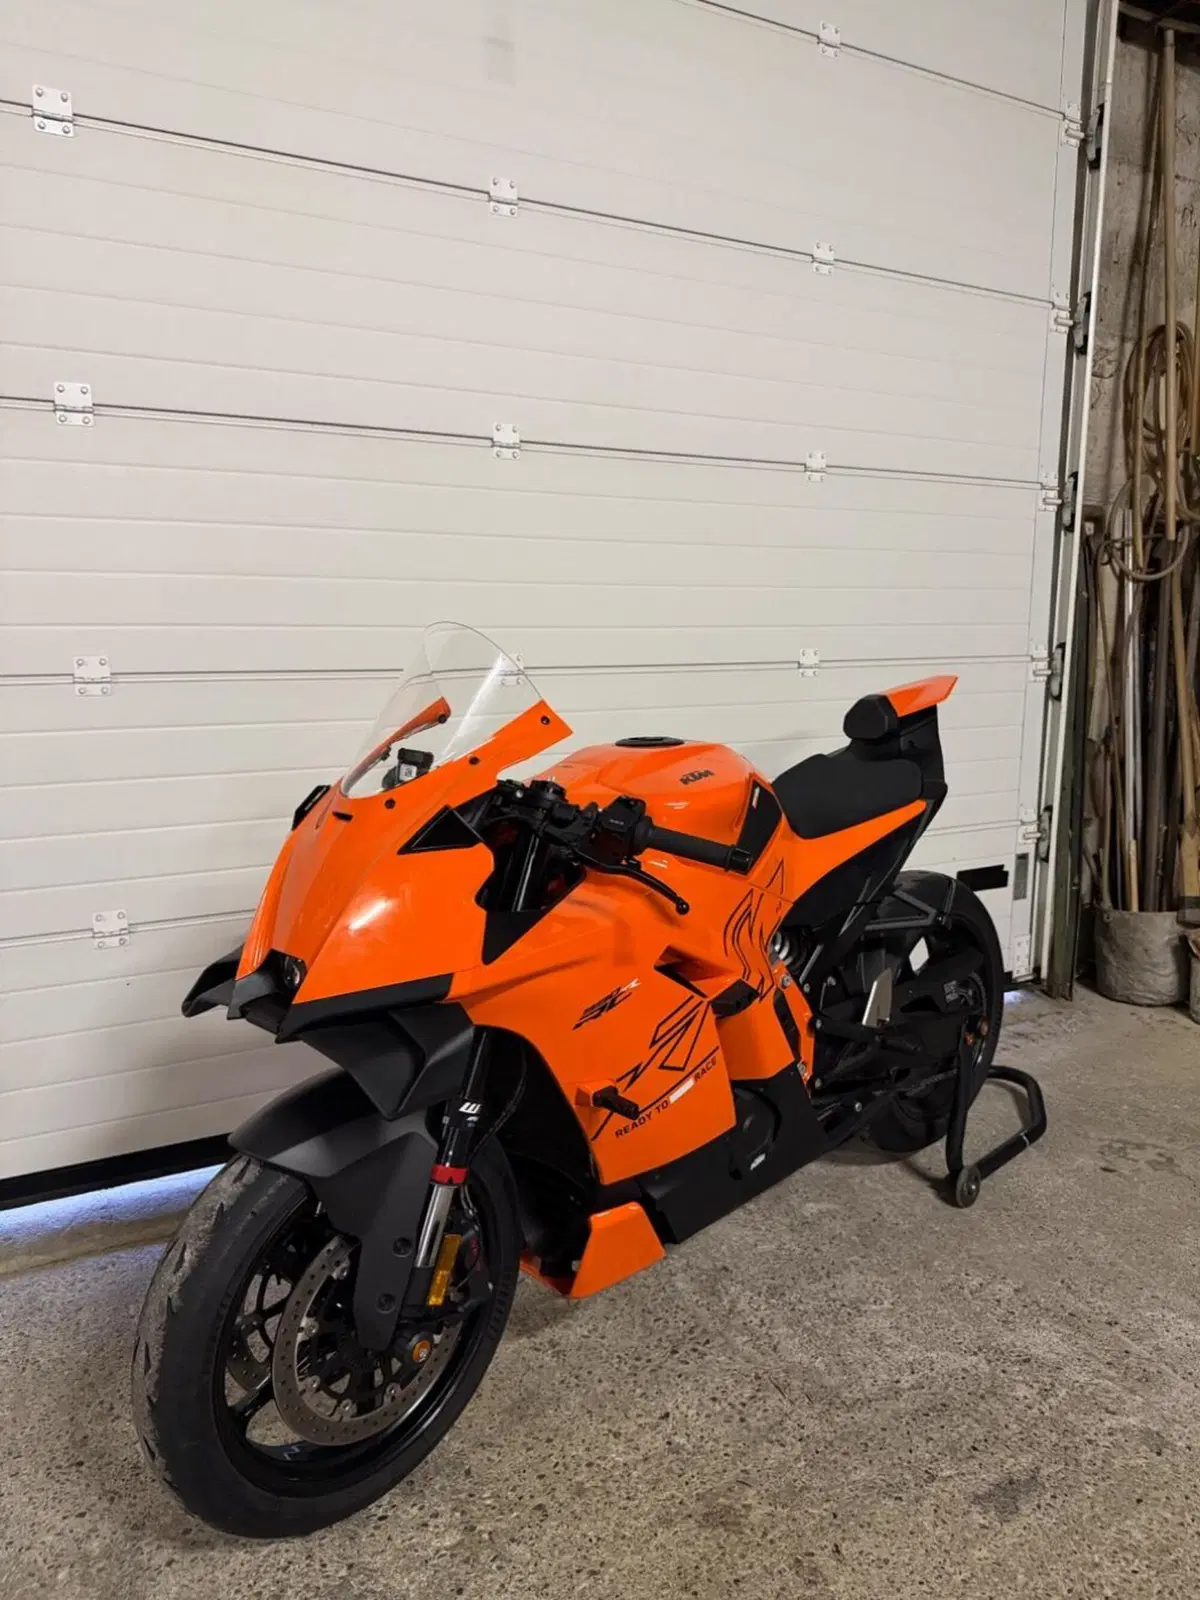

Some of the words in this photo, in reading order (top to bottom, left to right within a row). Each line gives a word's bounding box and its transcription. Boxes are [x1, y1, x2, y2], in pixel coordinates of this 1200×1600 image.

[679, 769, 714, 785] KTM
[614, 1111, 654, 1139] READY
[655, 1099, 670, 1114] TO
[694, 1056, 718, 1082] RACE
